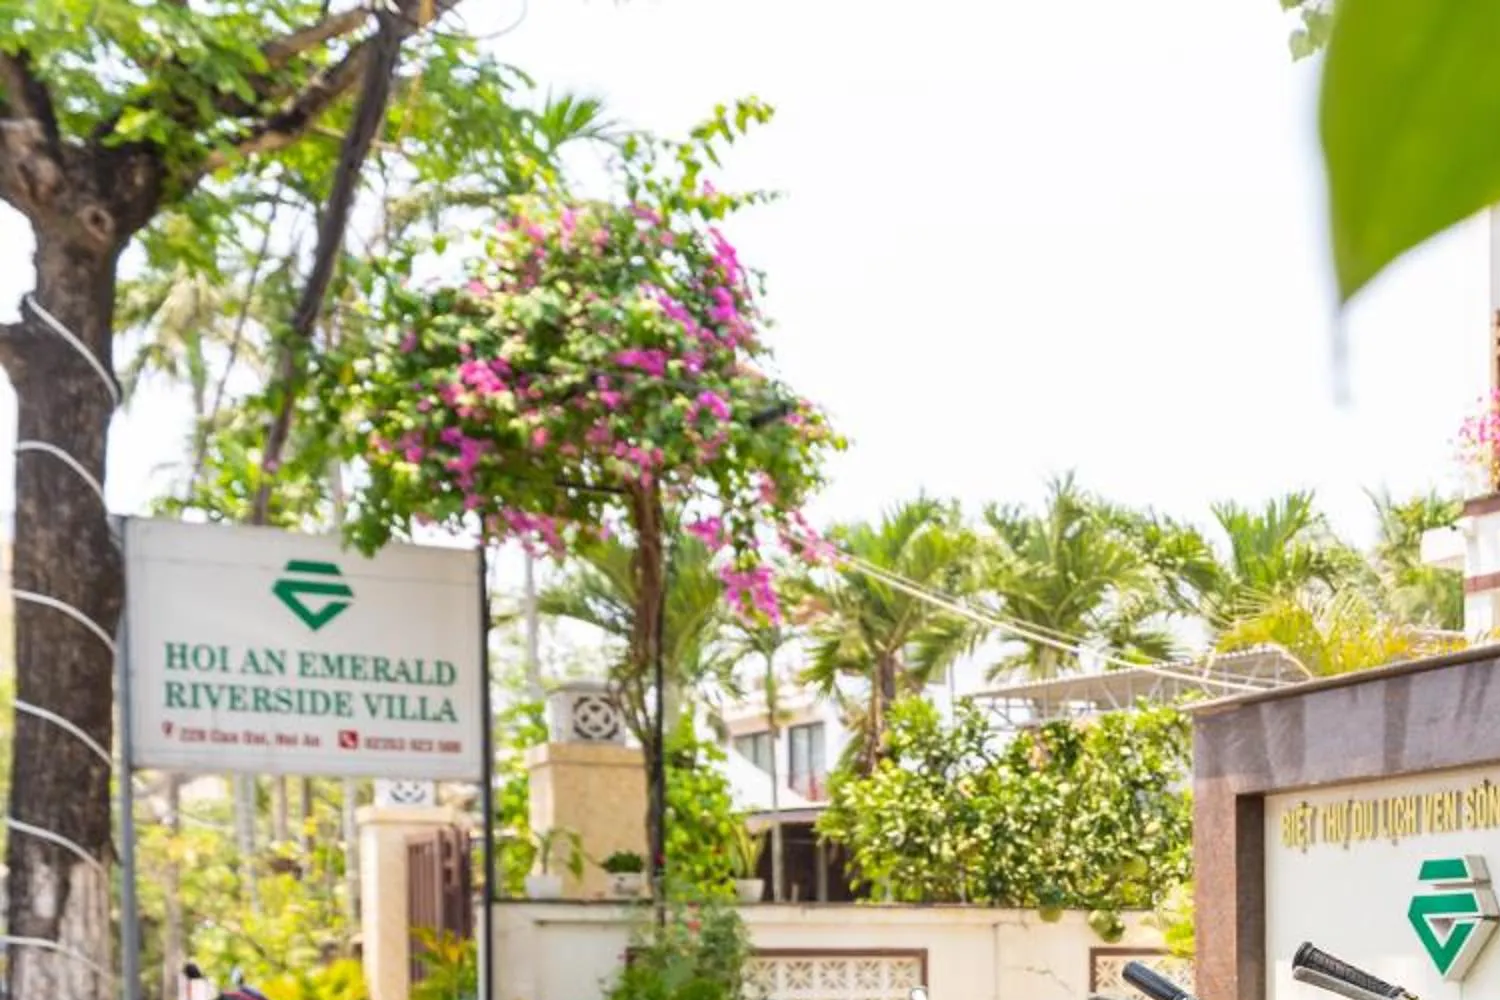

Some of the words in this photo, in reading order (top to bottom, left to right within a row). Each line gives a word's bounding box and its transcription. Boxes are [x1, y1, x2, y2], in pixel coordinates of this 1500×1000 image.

[164, 641, 229, 673] HOI
[240, 646, 288, 676] AN
[298, 651, 457, 687] EMERALD
[164, 681, 354, 719] RIVERSIDE
[362, 693, 458, 723] VILLA
[1280, 802, 1317, 853] BIỆT
[1350, 797, 1376, 842] DU
[1377, 796, 1417, 846] LỊCH
[1421, 792, 1462, 838] VEN
